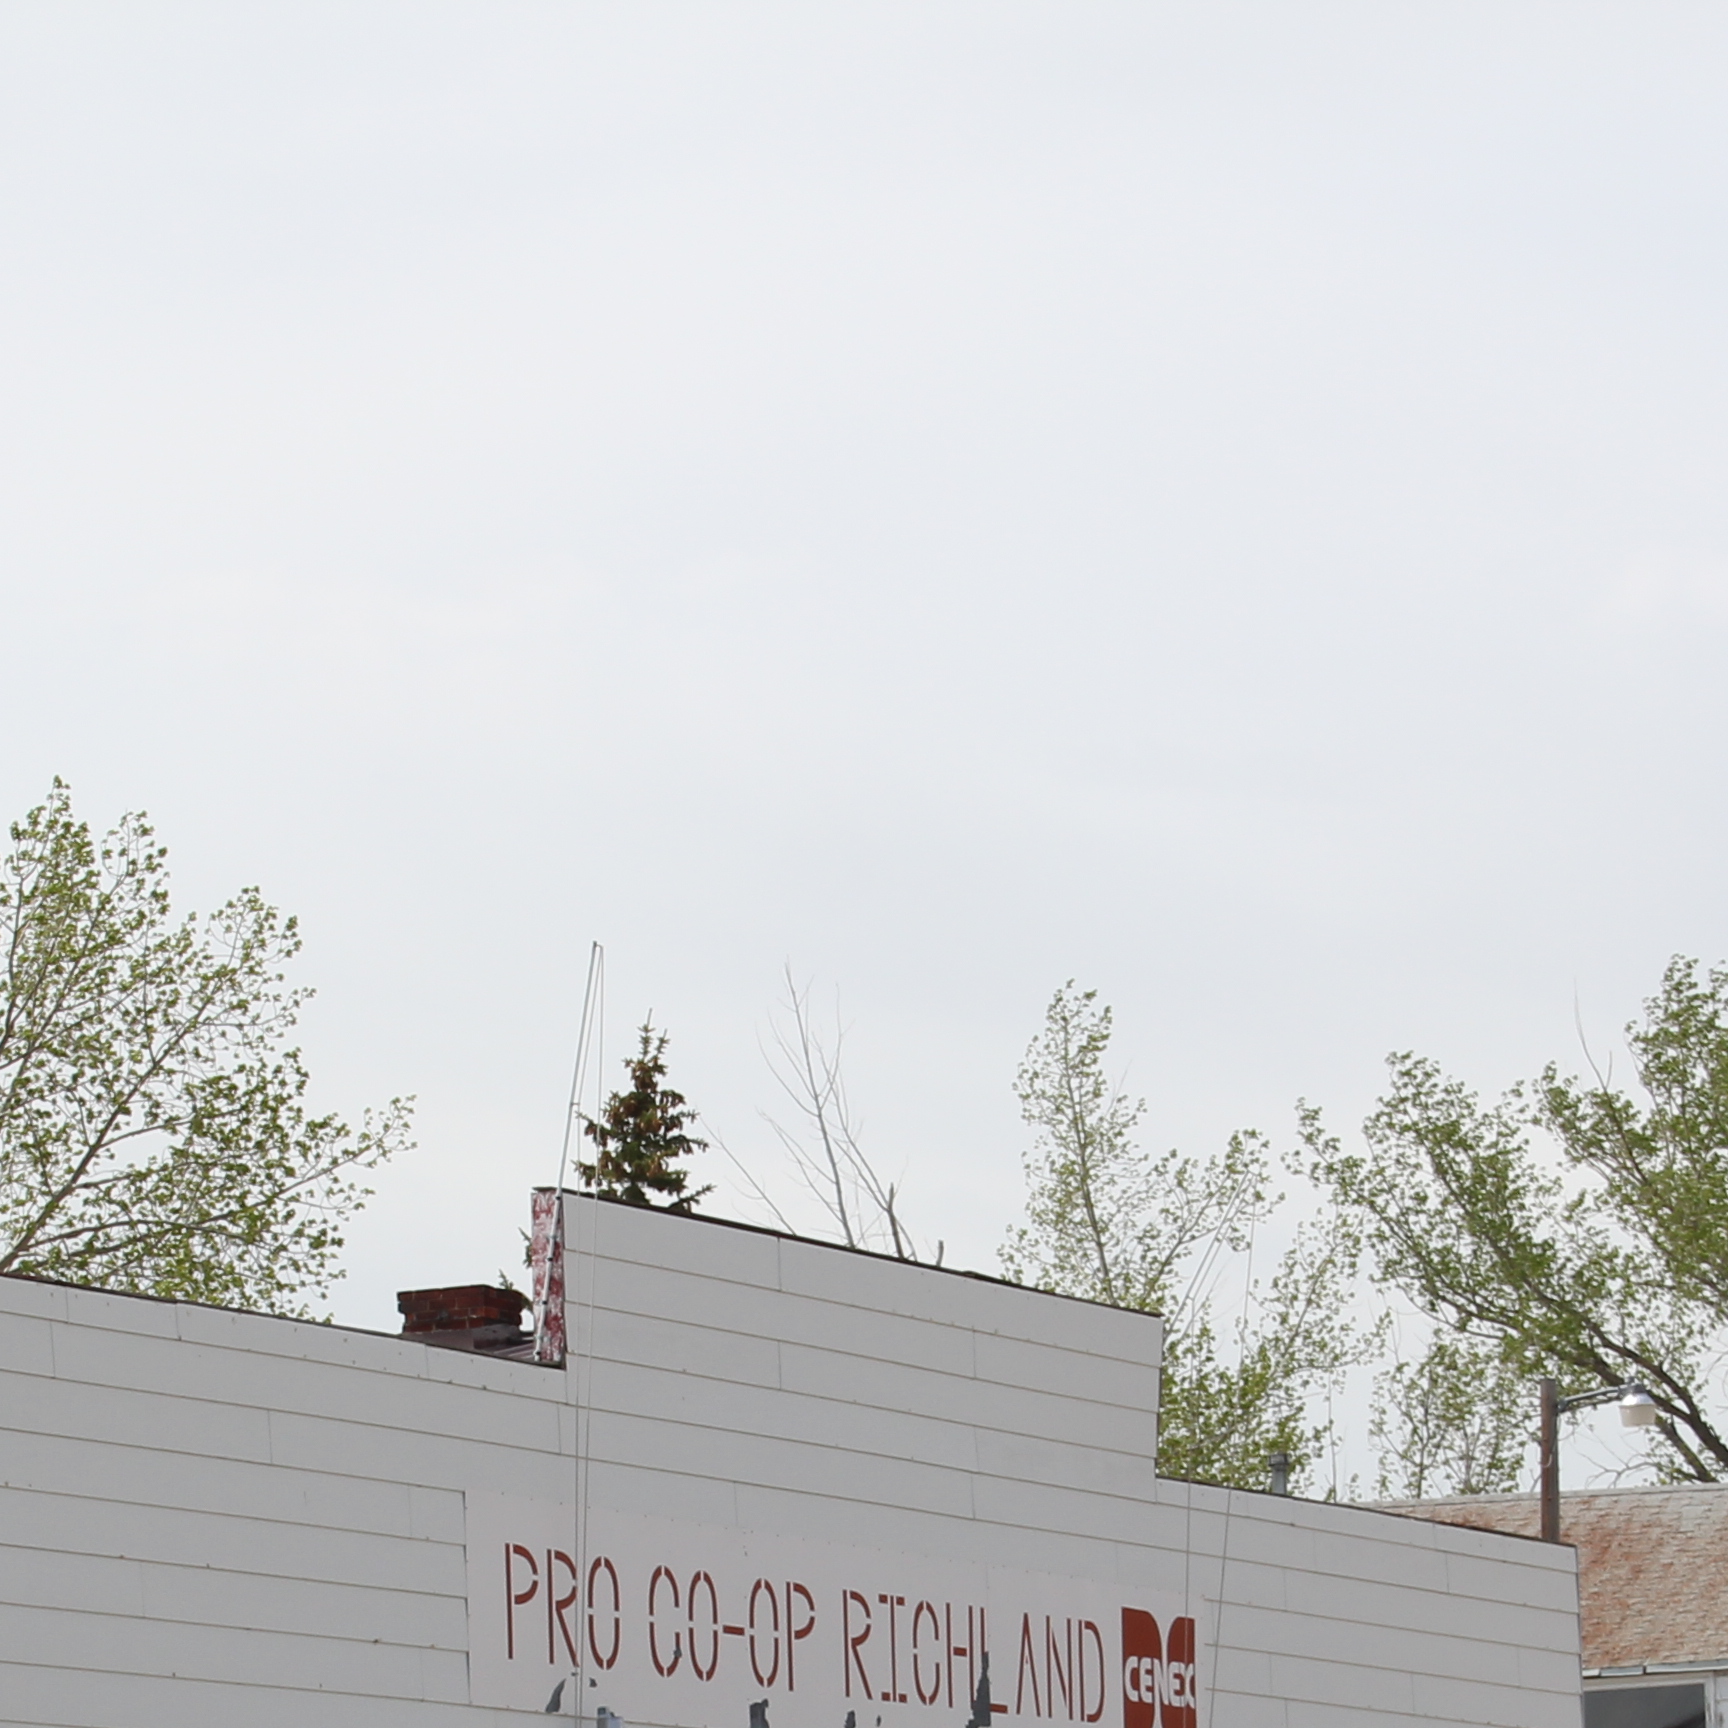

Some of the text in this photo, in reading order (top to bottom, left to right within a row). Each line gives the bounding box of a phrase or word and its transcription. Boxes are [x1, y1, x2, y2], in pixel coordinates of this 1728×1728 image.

[505, 1542, 1106, 1724] PRO CO-OP RICHLAND
[1124, 1655, 1197, 1710] CENEX
